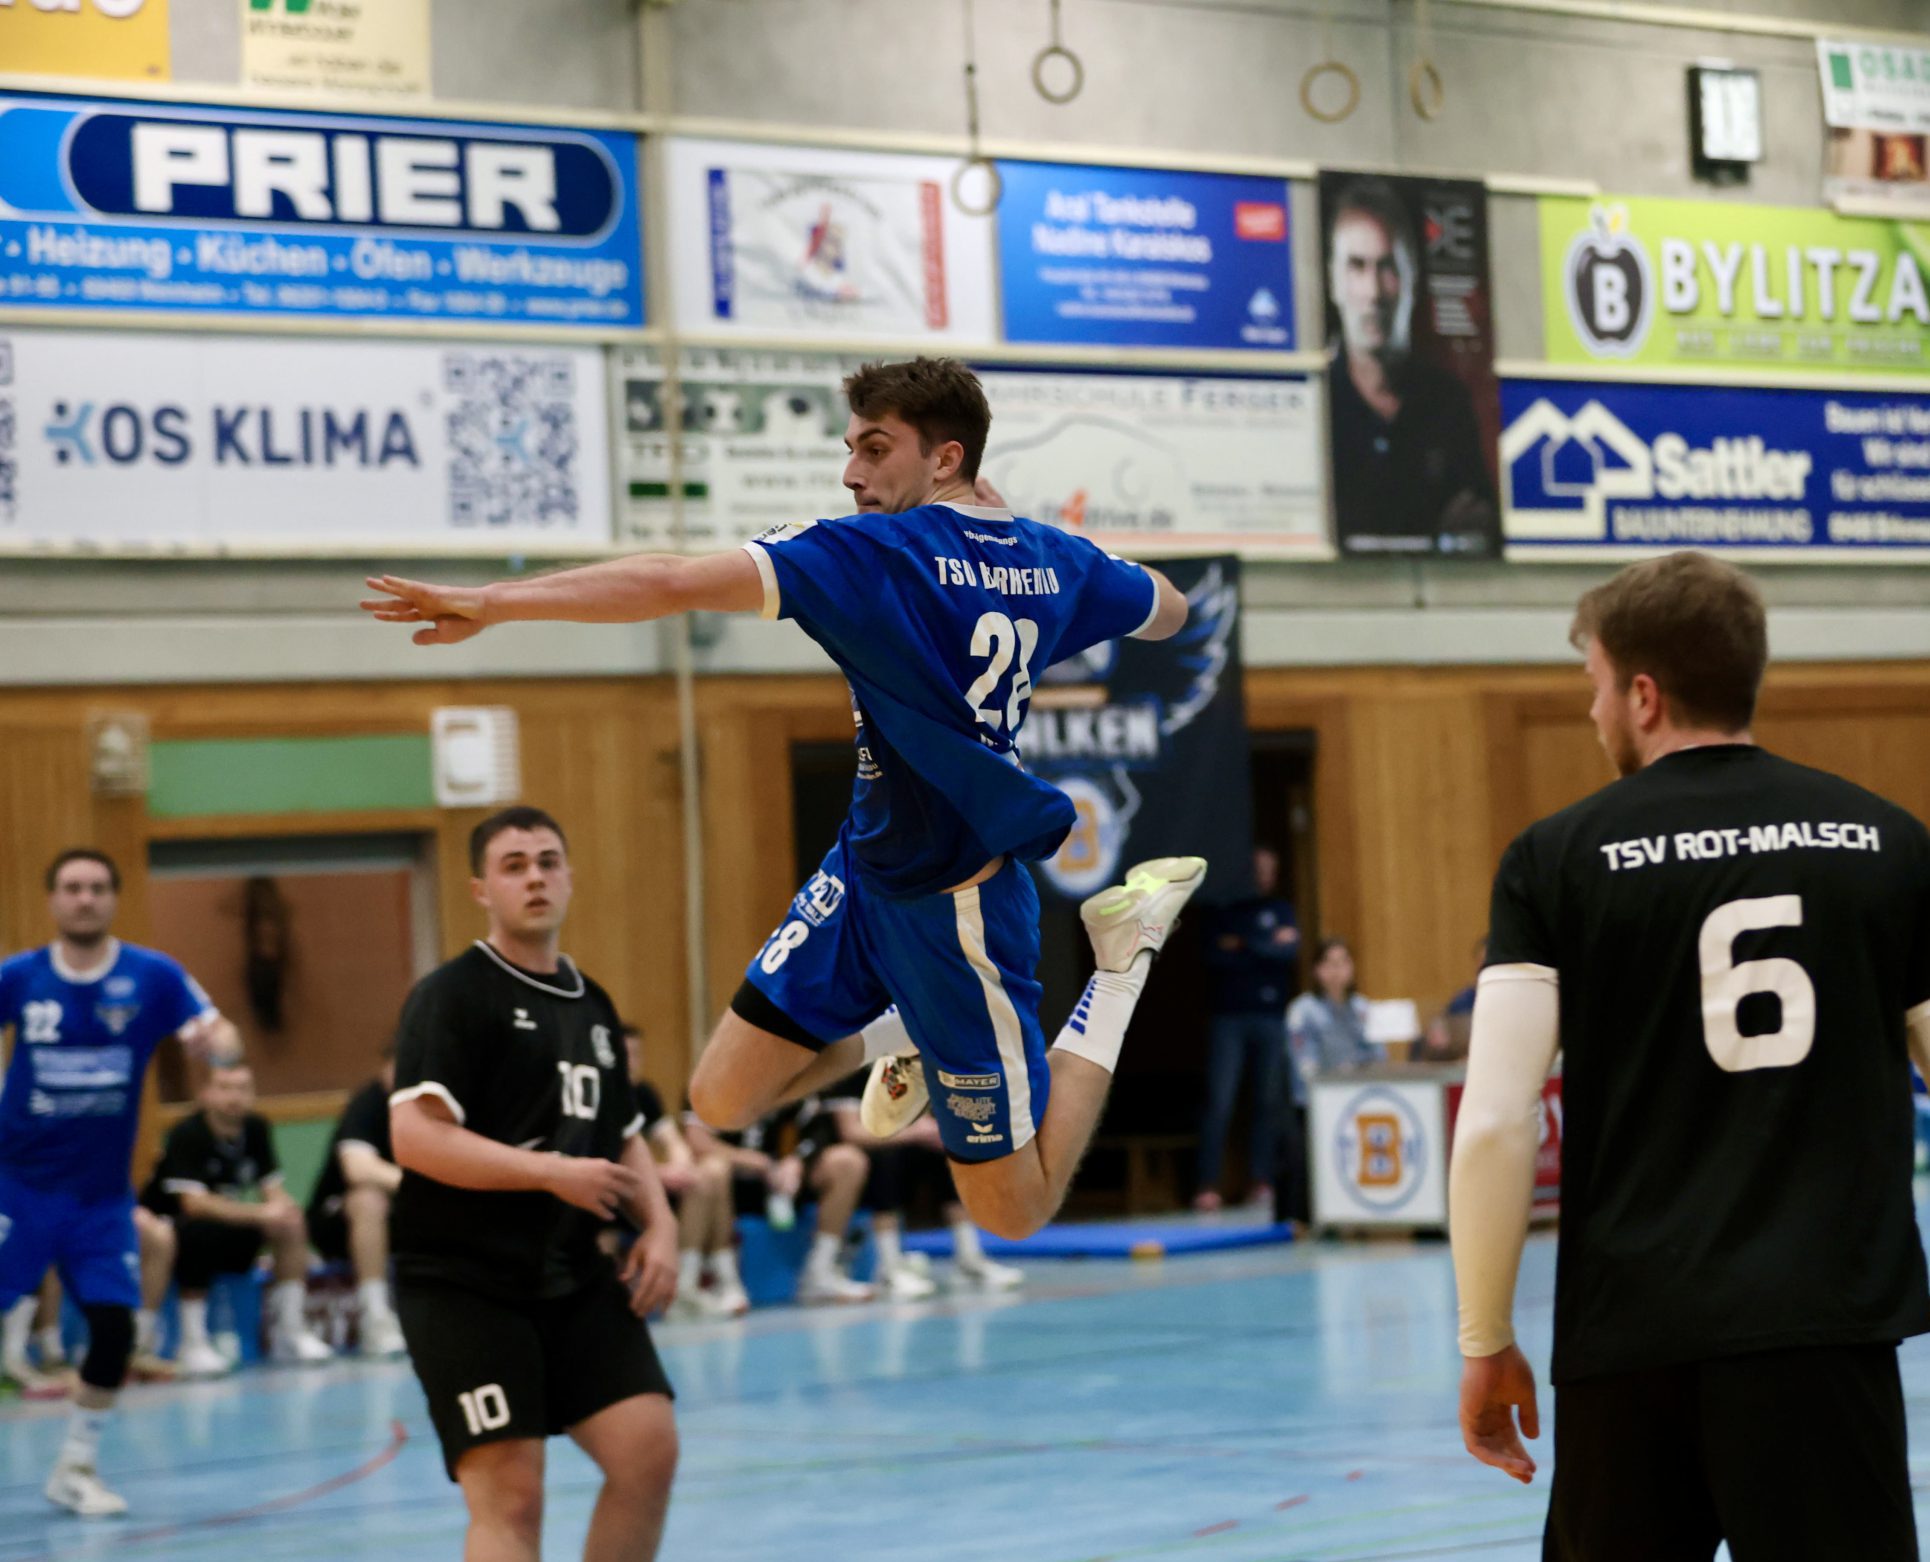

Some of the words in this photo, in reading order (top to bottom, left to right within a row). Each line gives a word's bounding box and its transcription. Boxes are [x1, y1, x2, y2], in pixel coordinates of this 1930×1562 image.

[131, 121, 563, 232] PRIER
[27, 225, 172, 279] Heizung
[195, 231, 329, 278] Küchen
[452, 245, 629, 298] Werkzeuge
[1660, 237, 1930, 324] BYLITZA
[1592, 262, 1631, 333] B
[214, 404, 422, 469] KLIMA
[1652, 431, 1813, 501] Sattler
[1600, 836, 1666, 871] TSV
[1674, 822, 1881, 860] ROT-MALSCH
[1698, 894, 1817, 1073] 6
[557, 1060, 601, 1121] 10
[954, 1076, 998, 1087] MAYER
[965, 1133, 1004, 1144] erima
[1355, 1113, 1403, 1187] B
[457, 1383, 511, 1436] 10
